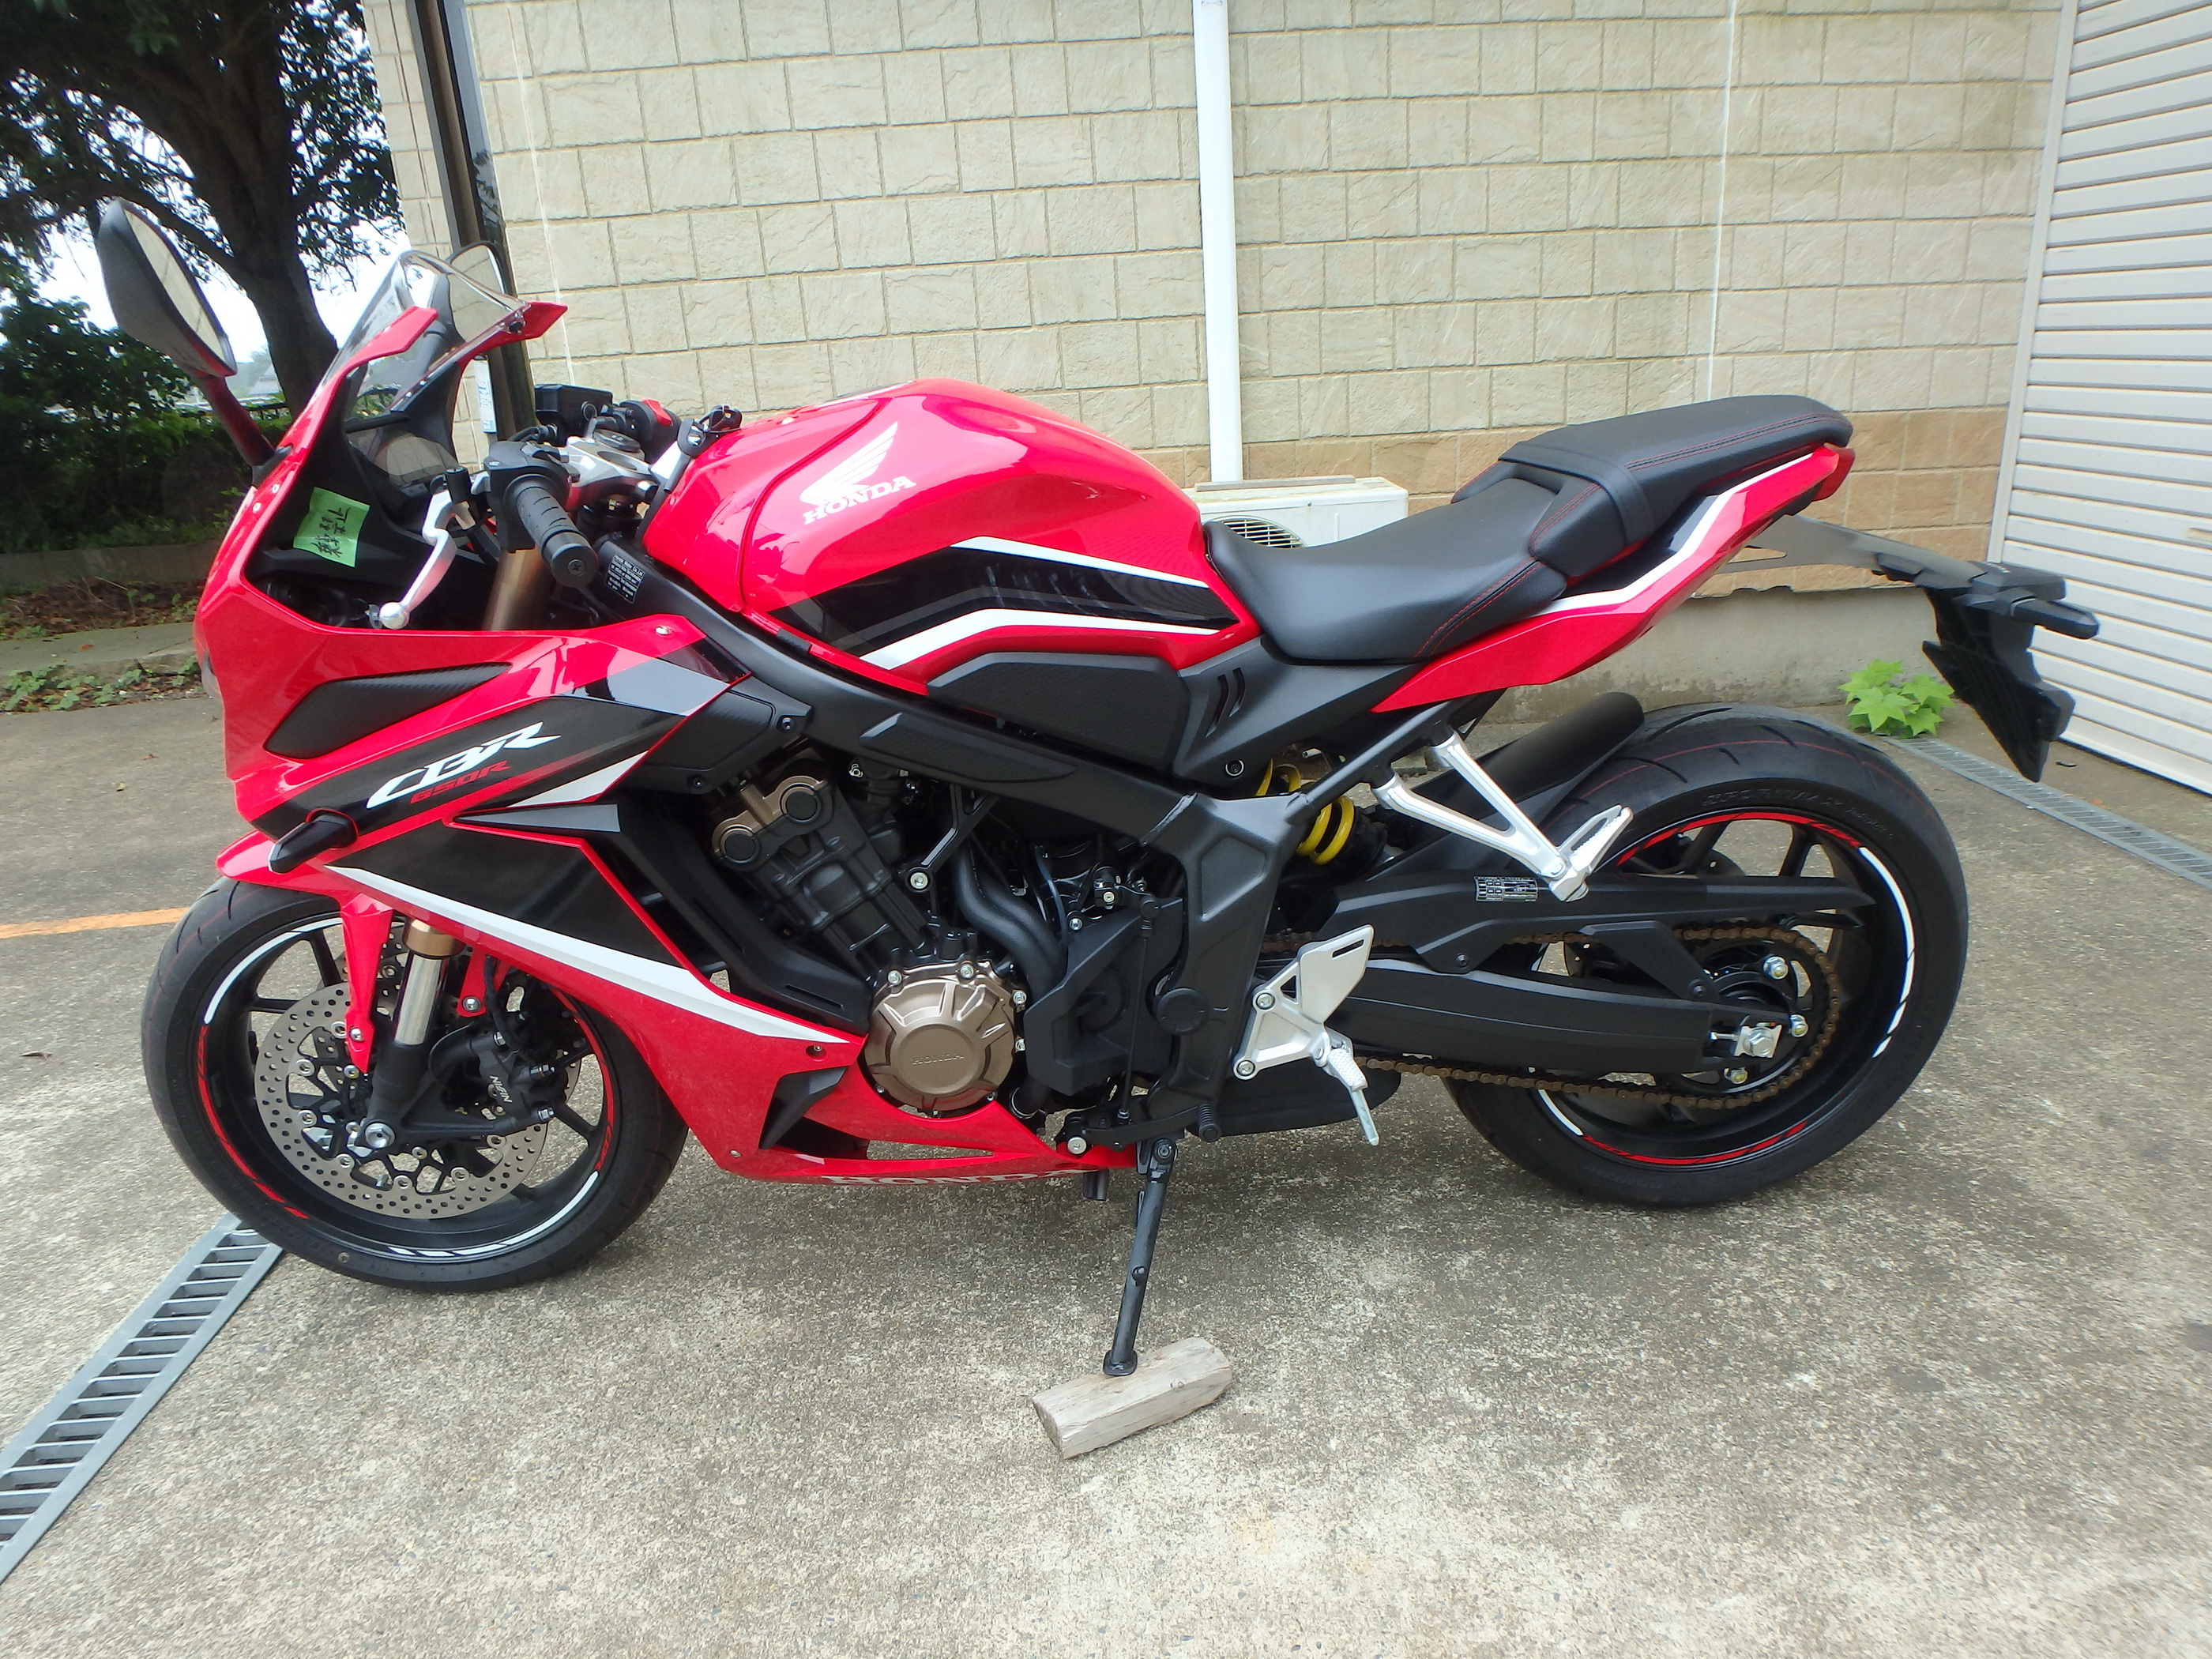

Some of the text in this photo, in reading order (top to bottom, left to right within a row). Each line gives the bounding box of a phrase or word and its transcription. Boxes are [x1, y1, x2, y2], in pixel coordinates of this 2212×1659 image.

[803, 476, 917, 525] HONDA
[366, 720, 562, 810] CBR
[410, 760, 512, 804] 650R
[911, 1052, 965, 1066] HONDA
[820, 1168, 1099, 1185] HONDA
